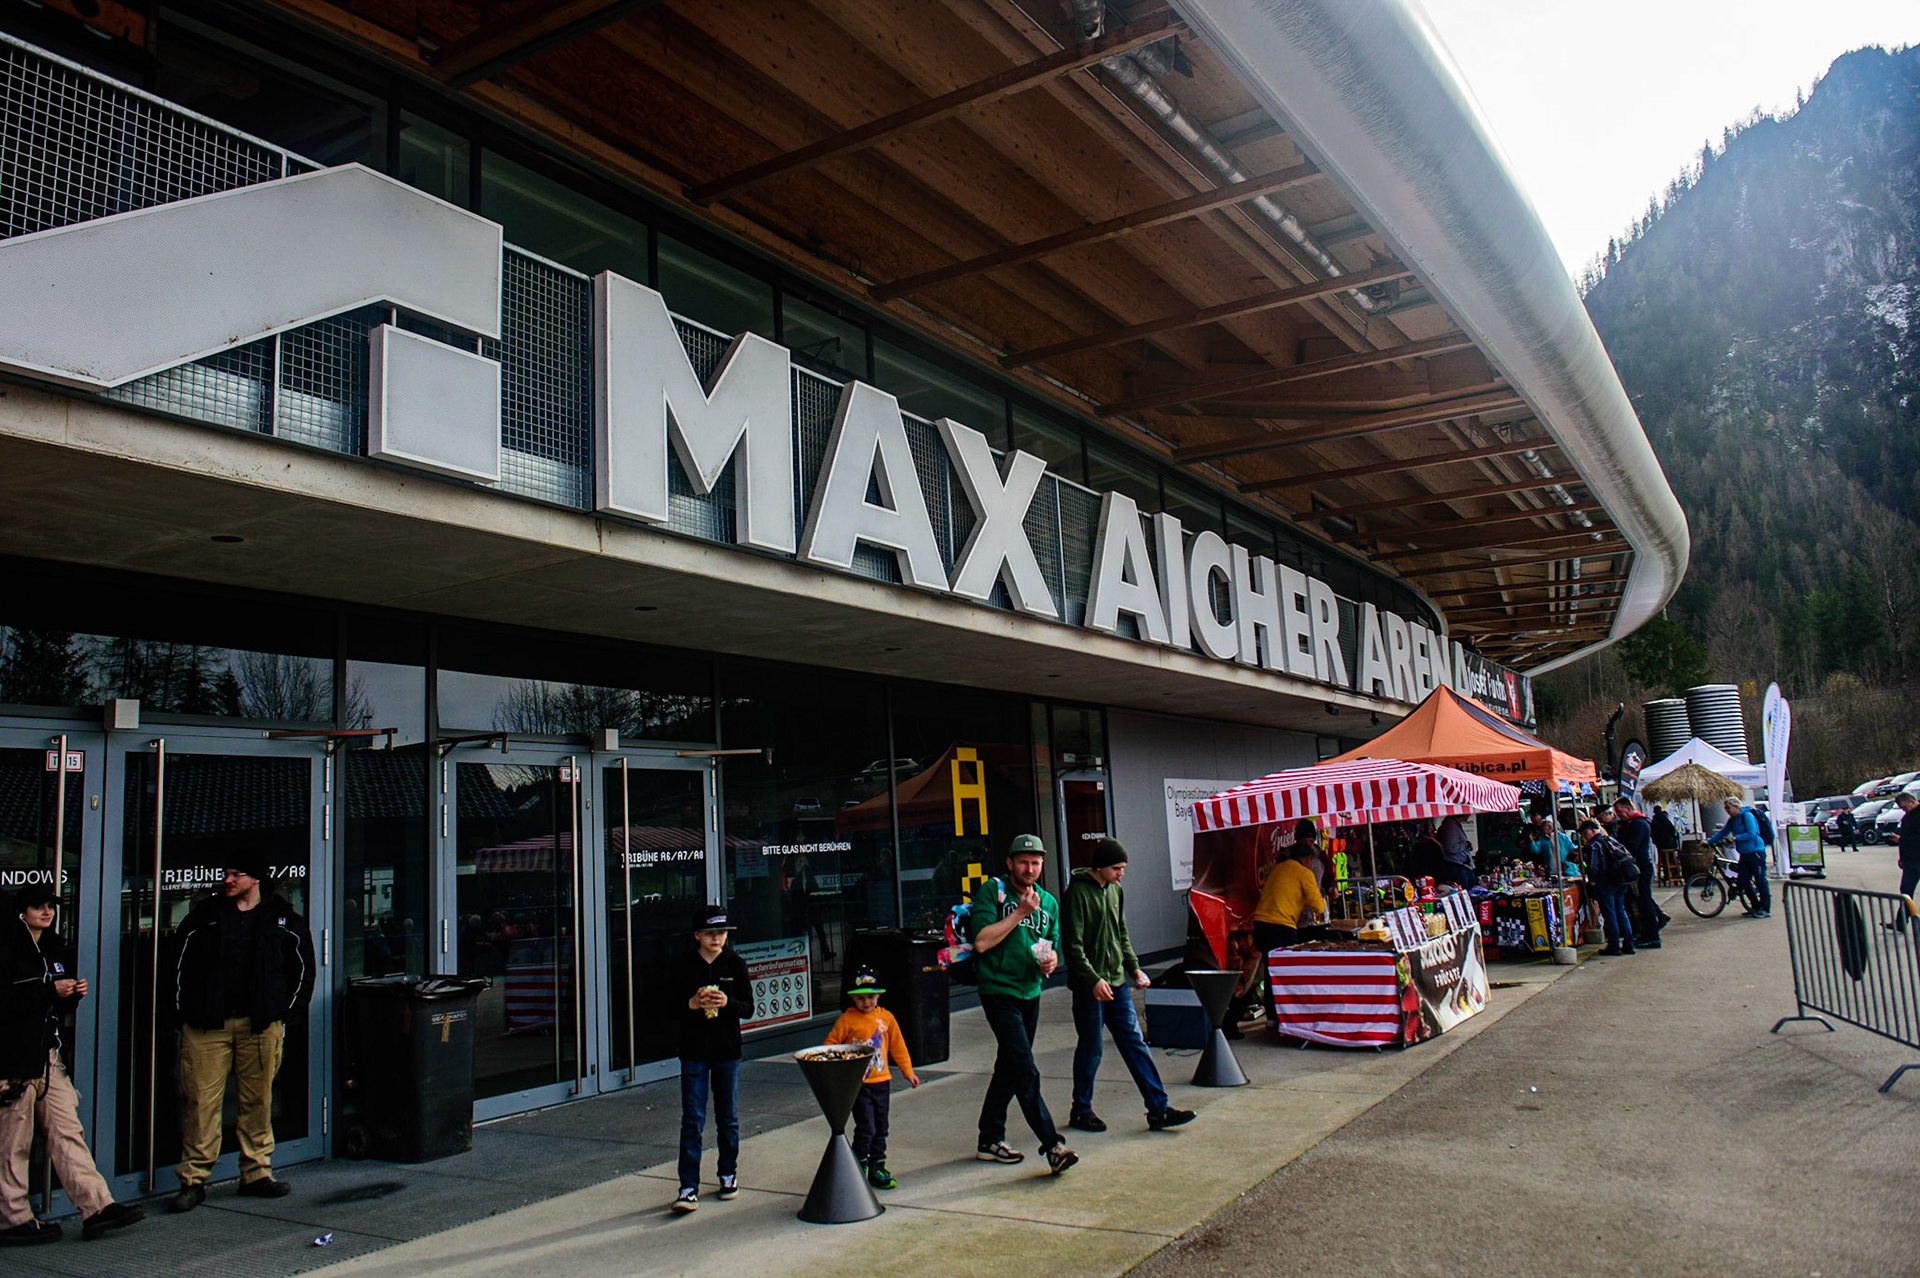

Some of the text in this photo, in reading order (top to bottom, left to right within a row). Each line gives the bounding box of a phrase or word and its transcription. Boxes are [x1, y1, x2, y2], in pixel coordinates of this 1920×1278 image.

[594, 270, 1473, 704] MAX AICHER ARENA
[951, 747, 989, 836] A
[1175, 803, 1192, 821] Baye
[660, 850, 704, 862] A6/A7/A8
[762, 841, 852, 855] BITTE GLAS NICHT BERÜHREN
[1, 869, 68, 885] NDOWS
[161, 866, 223, 883] RIBÜNE
